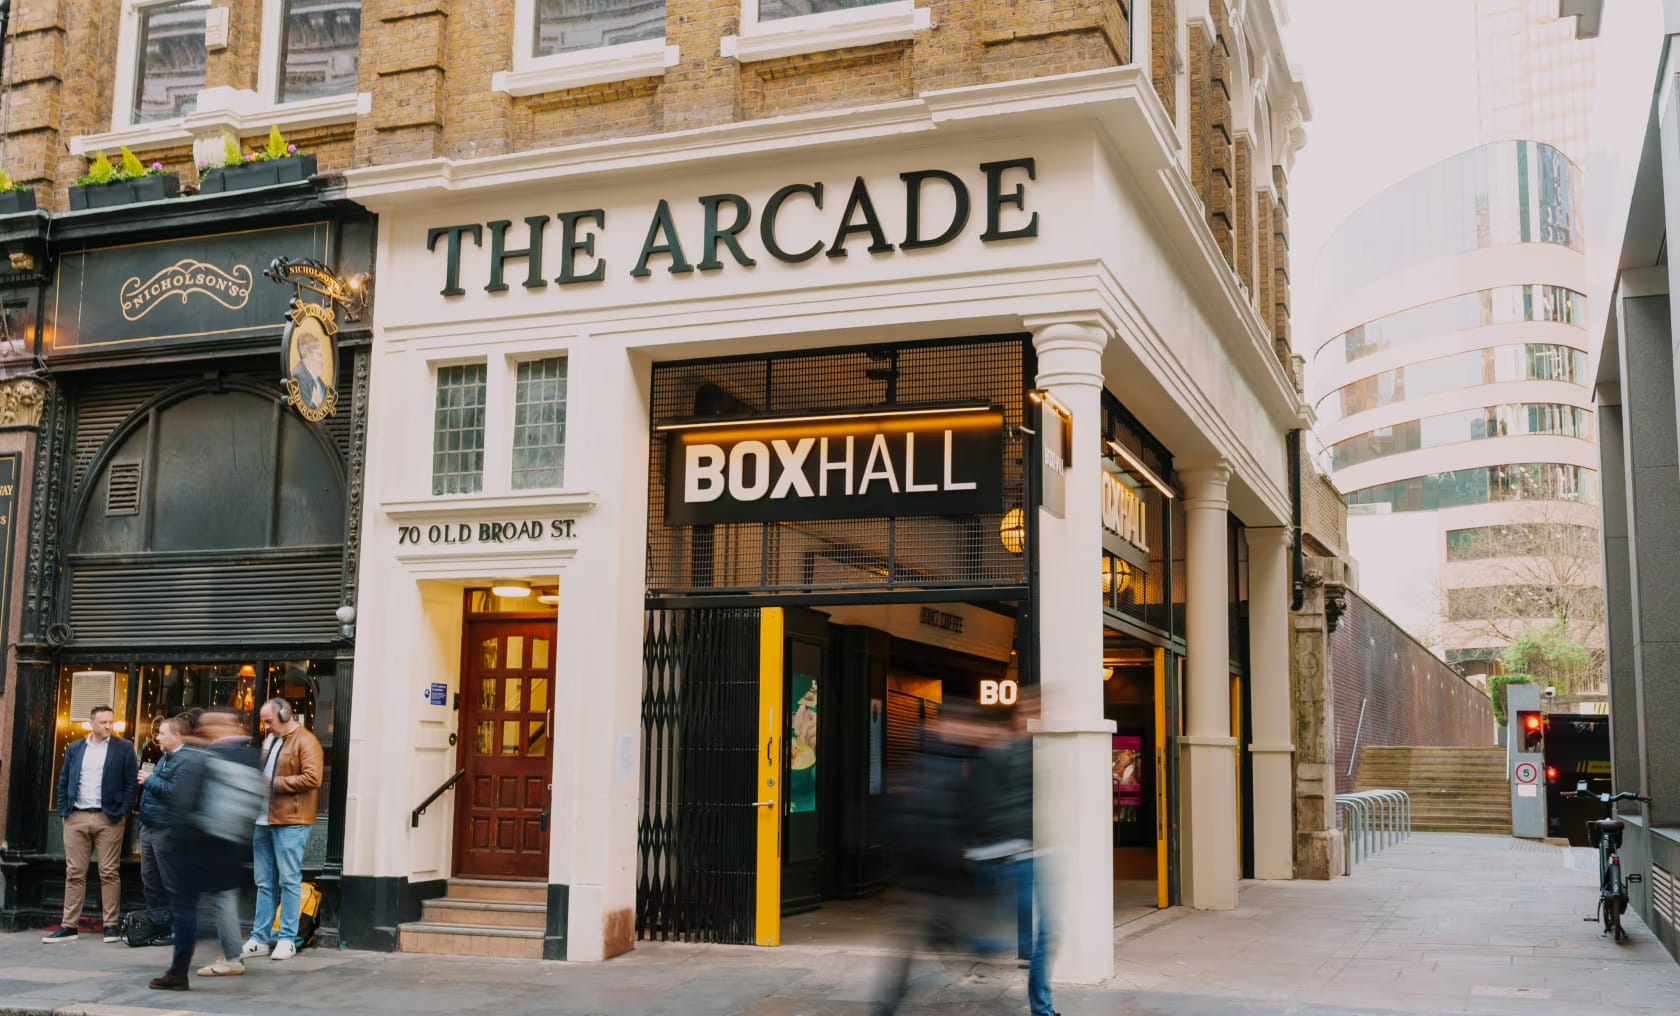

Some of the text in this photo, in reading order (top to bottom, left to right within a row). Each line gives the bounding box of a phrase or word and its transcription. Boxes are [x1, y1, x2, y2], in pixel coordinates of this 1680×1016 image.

[427, 157, 1039, 298] THE ARCADE
[132, 273, 240, 309] NICHOLSON'S
[683, 429, 977, 503] BOXHALL
[399, 519, 577, 545] 70 OLD BROAD ST.
[1101, 471, 1149, 553] OXHALL
[1523, 769, 1530, 777] 5
